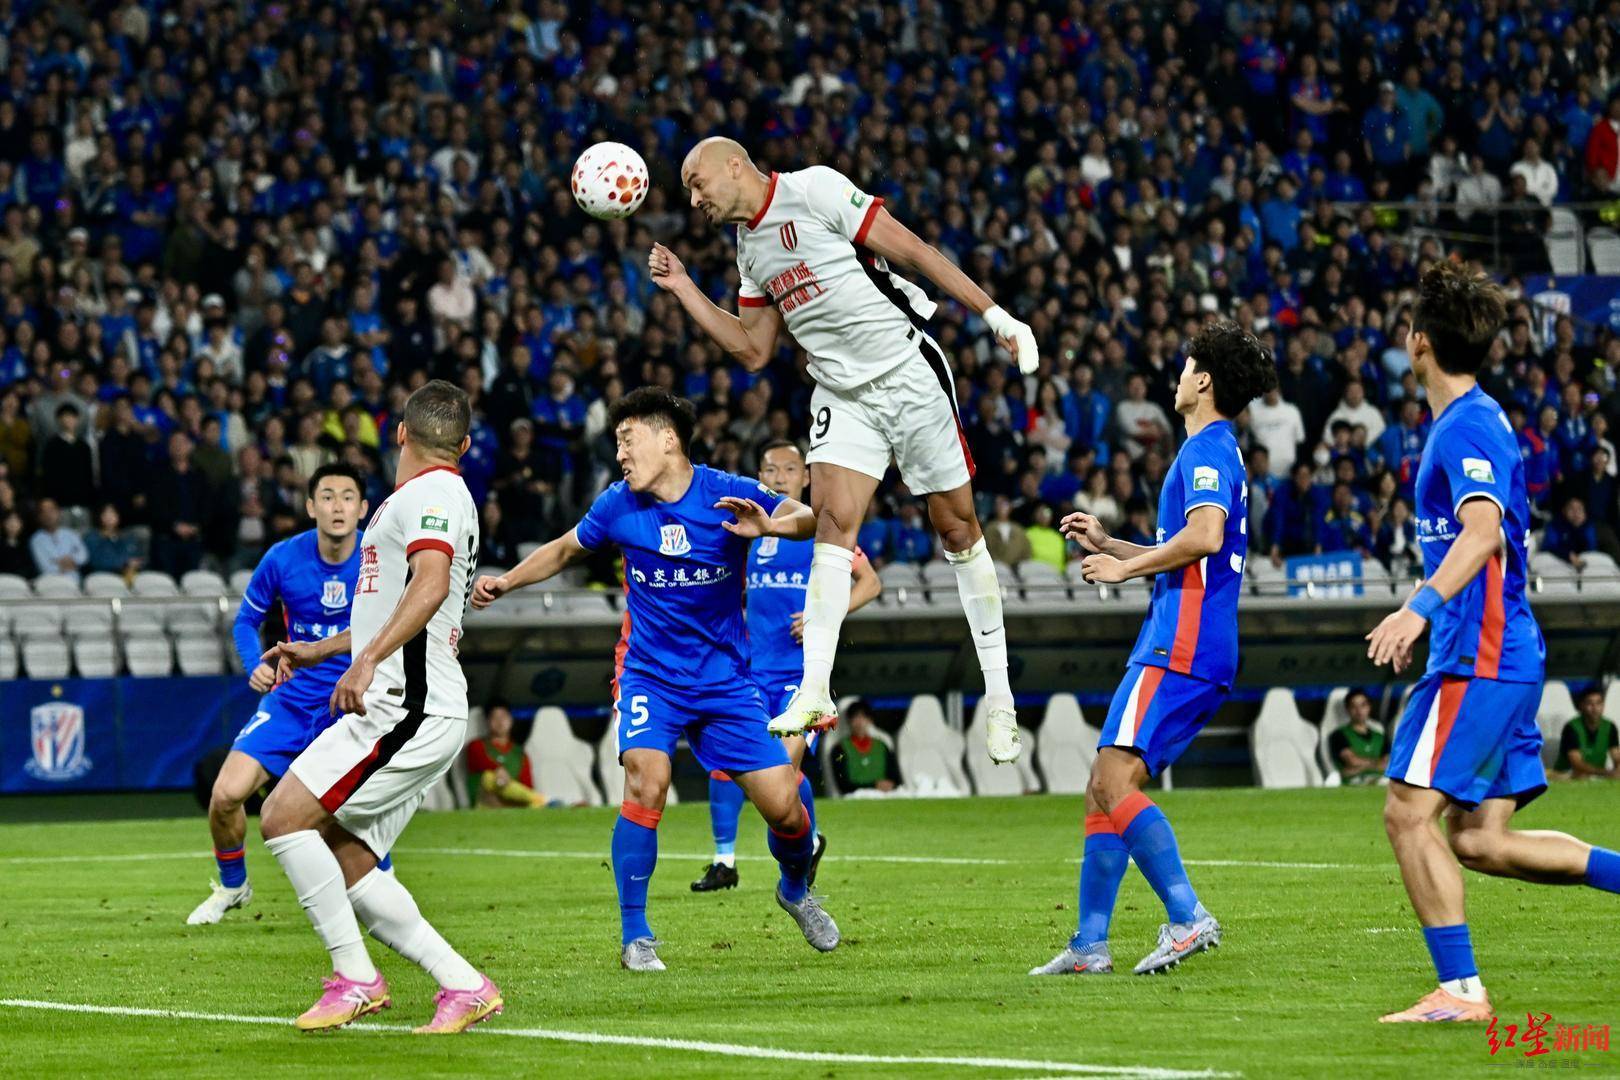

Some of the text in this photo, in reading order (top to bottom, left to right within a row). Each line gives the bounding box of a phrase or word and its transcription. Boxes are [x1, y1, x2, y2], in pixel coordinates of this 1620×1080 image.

[767, 260, 814, 299] 都蓉城
[779, 282, 829, 315] 都建工
[815, 406, 832, 440] 9
[630, 695, 649, 726] 5
